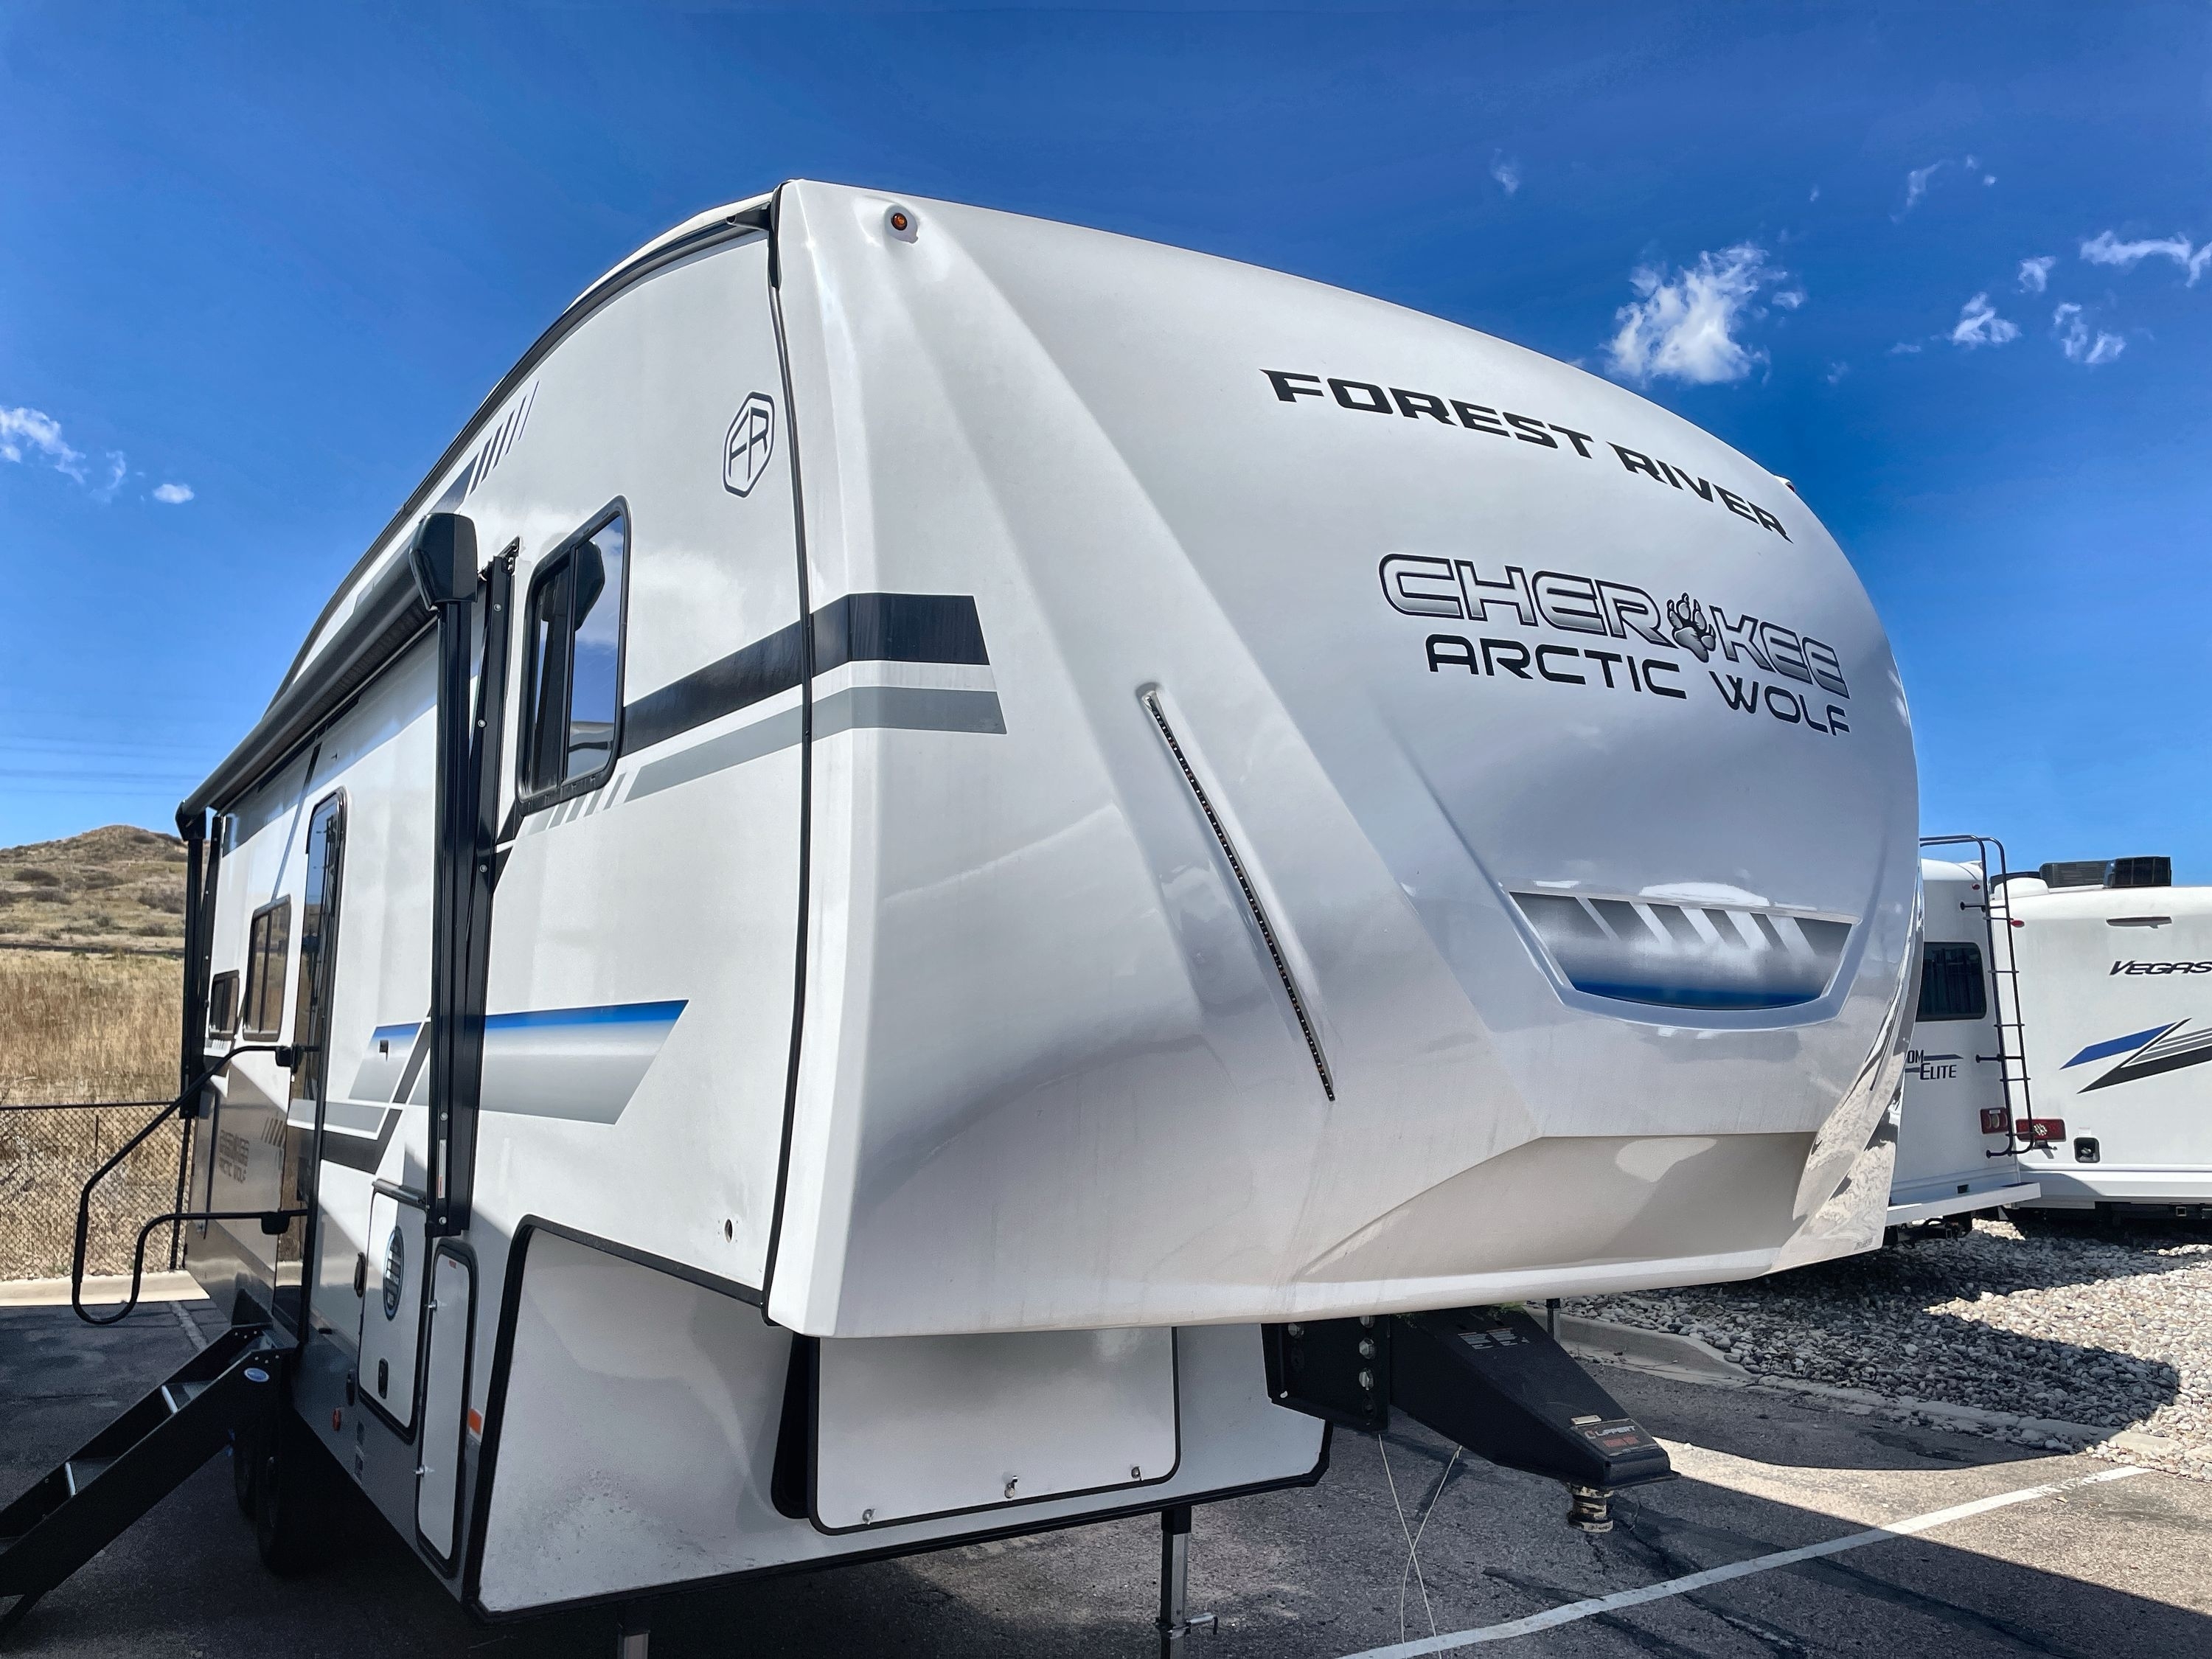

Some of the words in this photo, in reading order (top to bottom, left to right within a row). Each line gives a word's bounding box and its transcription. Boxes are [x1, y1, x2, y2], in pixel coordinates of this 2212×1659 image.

[1259, 368, 1594, 459] FOREST
[1606, 441, 1793, 543] RIVER
[1425, 635, 1687, 700] ARCTIC
[1708, 671, 1851, 736] WOLF
[2109, 960, 2212, 975] VEGAS
[1907, 1050, 1924, 1064] OM
